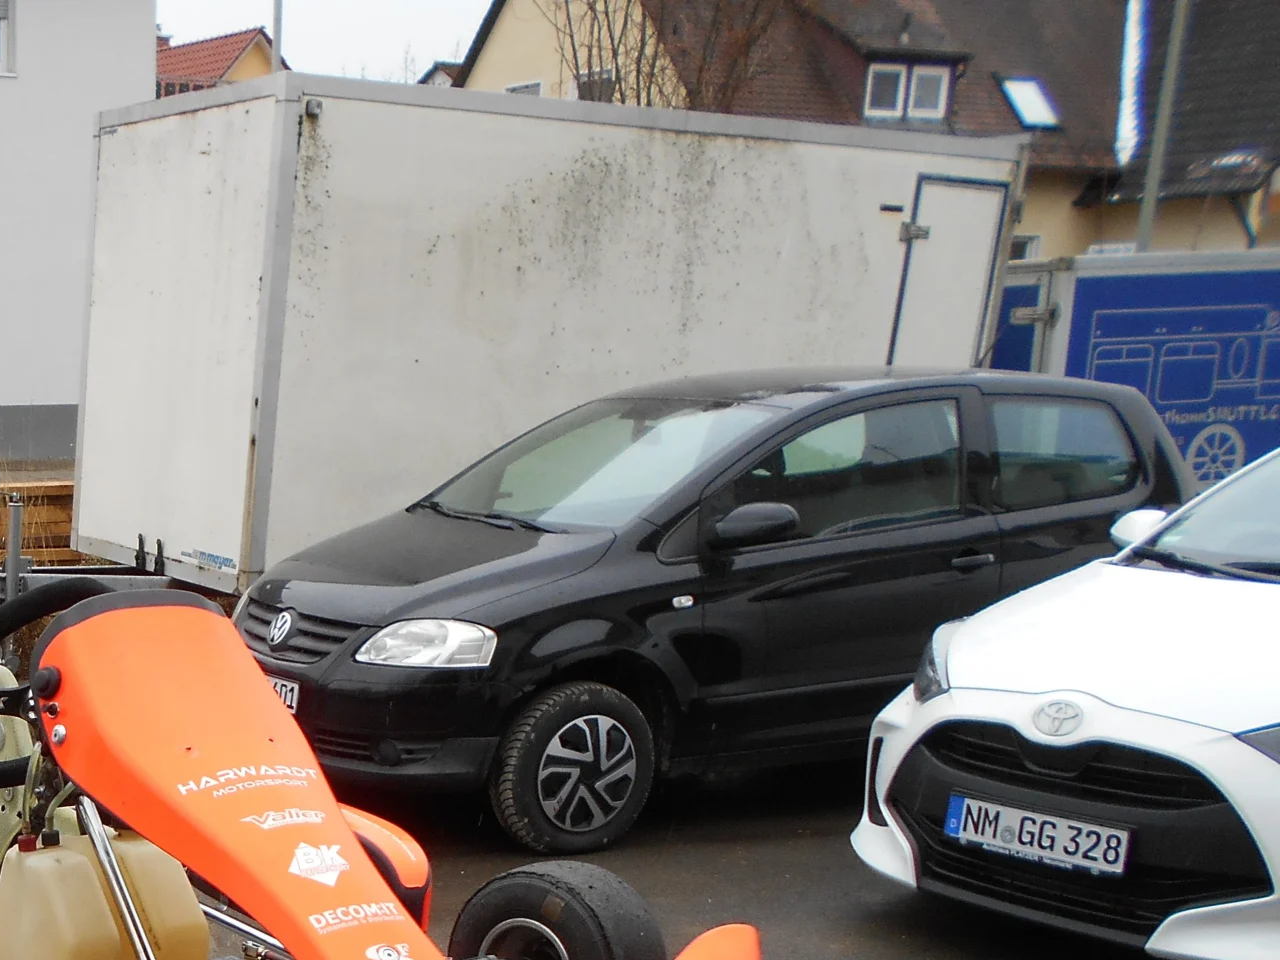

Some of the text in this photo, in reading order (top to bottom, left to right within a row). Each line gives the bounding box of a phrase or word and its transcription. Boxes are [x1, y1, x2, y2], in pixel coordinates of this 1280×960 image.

[177, 764, 317, 795] HARWARDT
[213, 778, 309, 798] MOTORSPORT
[963, 803, 1001, 839] NM
[1017, 816, 1057, 852] GG
[1063, 825, 1122, 865] 328
